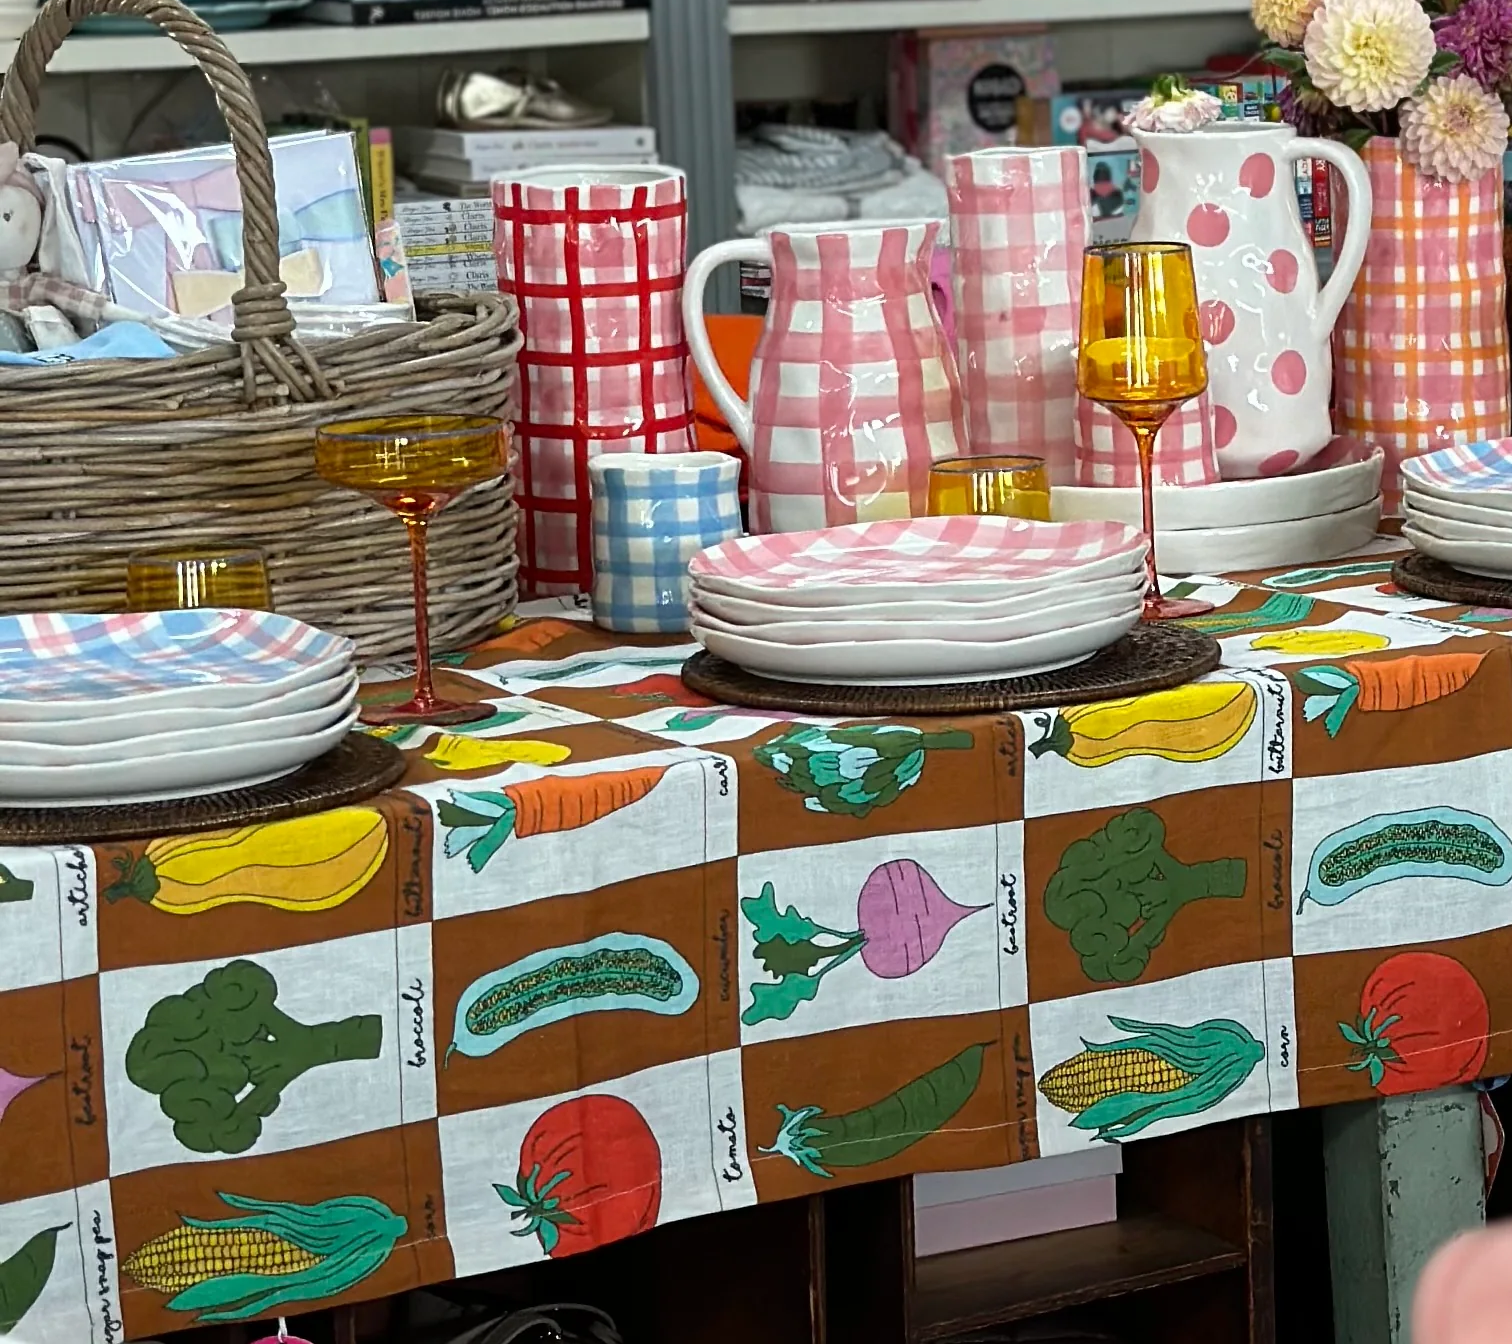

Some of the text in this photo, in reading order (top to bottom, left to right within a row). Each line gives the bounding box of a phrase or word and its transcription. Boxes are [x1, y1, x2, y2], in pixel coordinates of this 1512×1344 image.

[1267, 683, 1285, 774] butternut
[66, 849, 88, 928] articho
[1000, 872, 1020, 956] beetroot
[402, 977, 426, 1069] broccoli
[1281, 1024, 1290, 1068] corn
[717, 1106, 743, 1183] tomato
[92, 1209, 113, 1244] pea
[97, 1248, 114, 1296] snap
